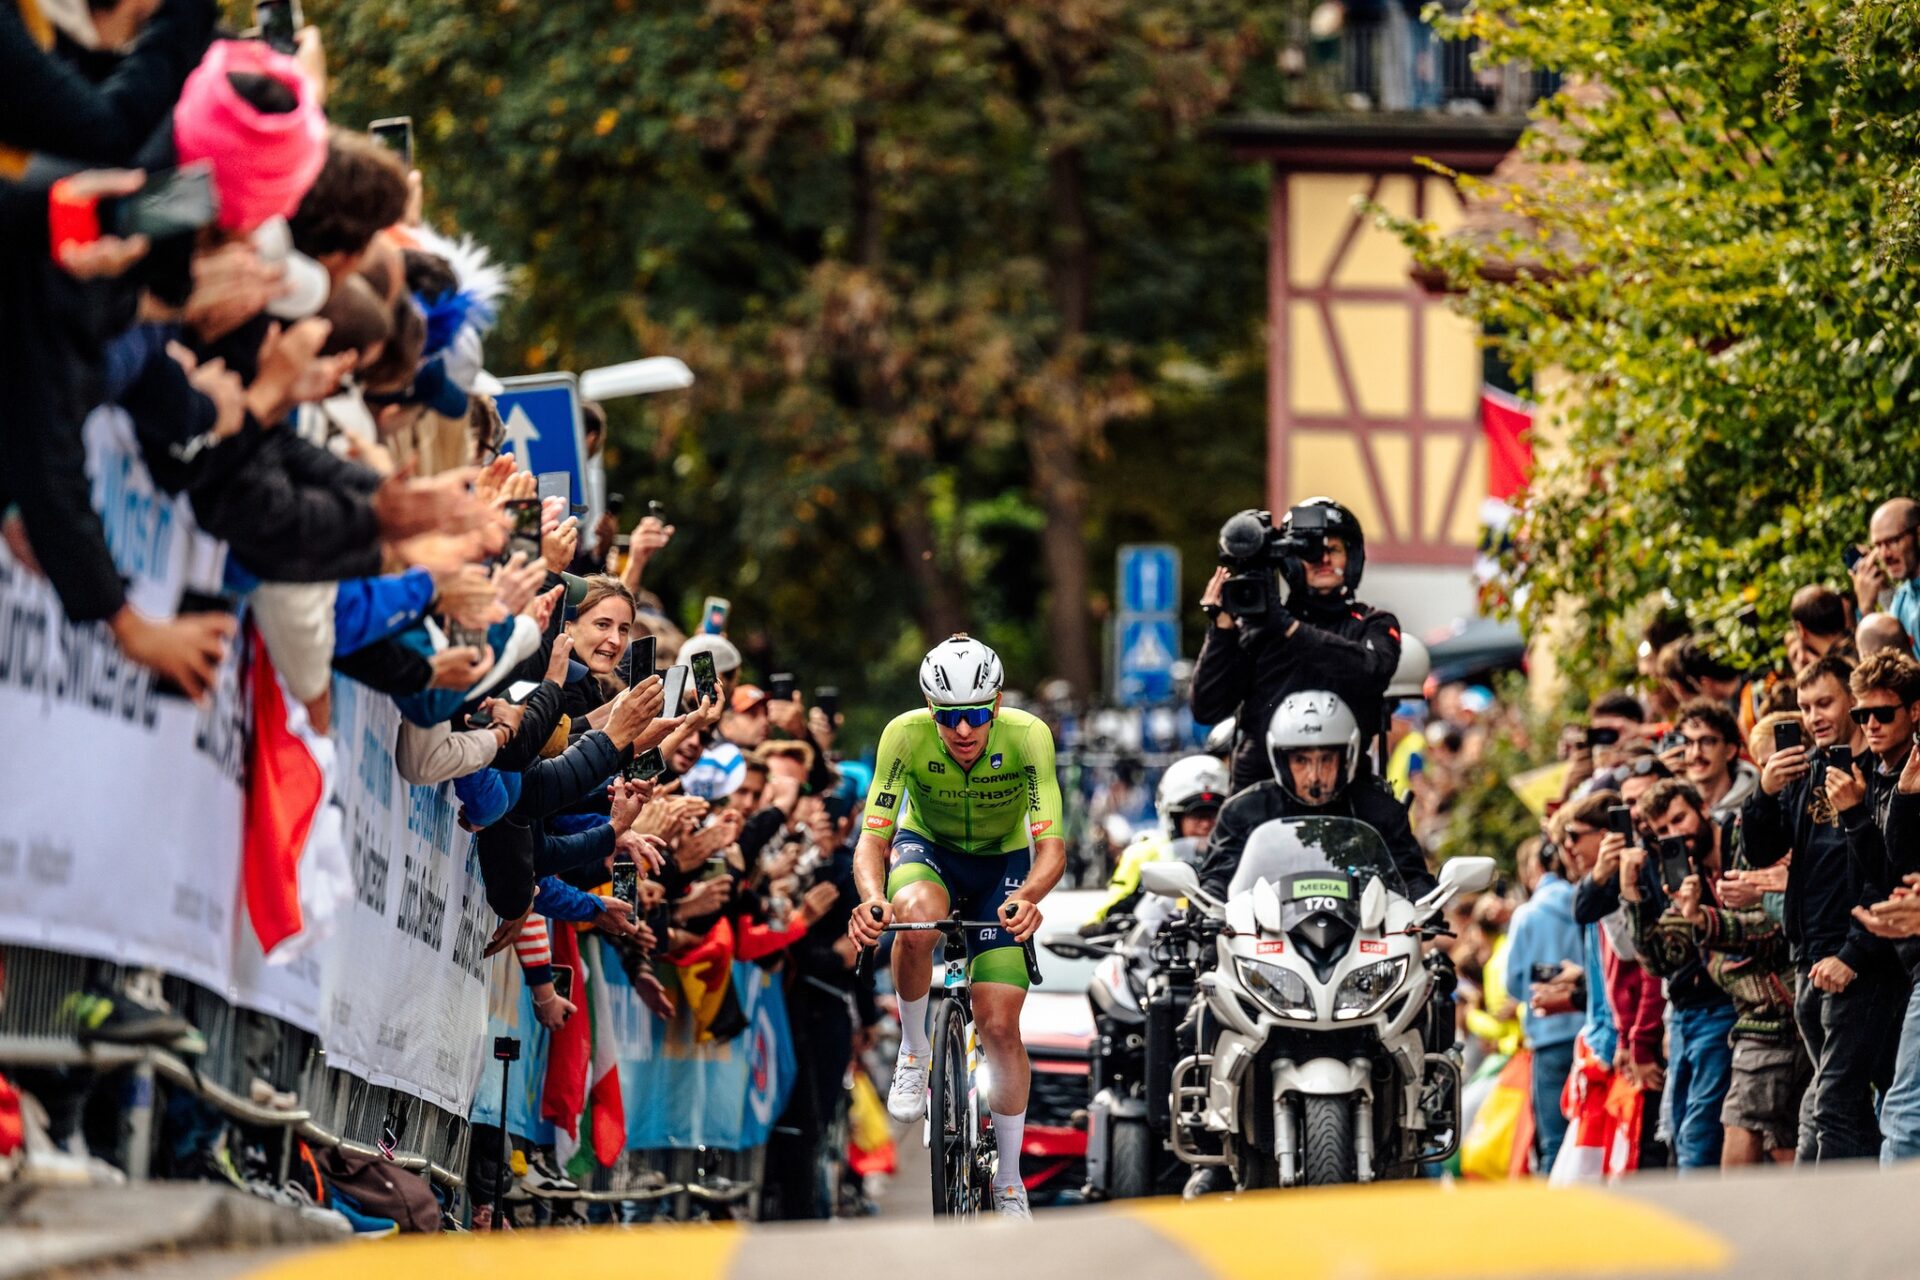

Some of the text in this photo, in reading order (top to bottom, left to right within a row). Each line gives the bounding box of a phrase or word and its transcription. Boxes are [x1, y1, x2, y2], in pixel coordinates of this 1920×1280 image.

[971, 772, 1019, 783] CORWIN
[1300, 883, 1341, 892] MEDIA
[1304, 897, 1337, 911] 170
